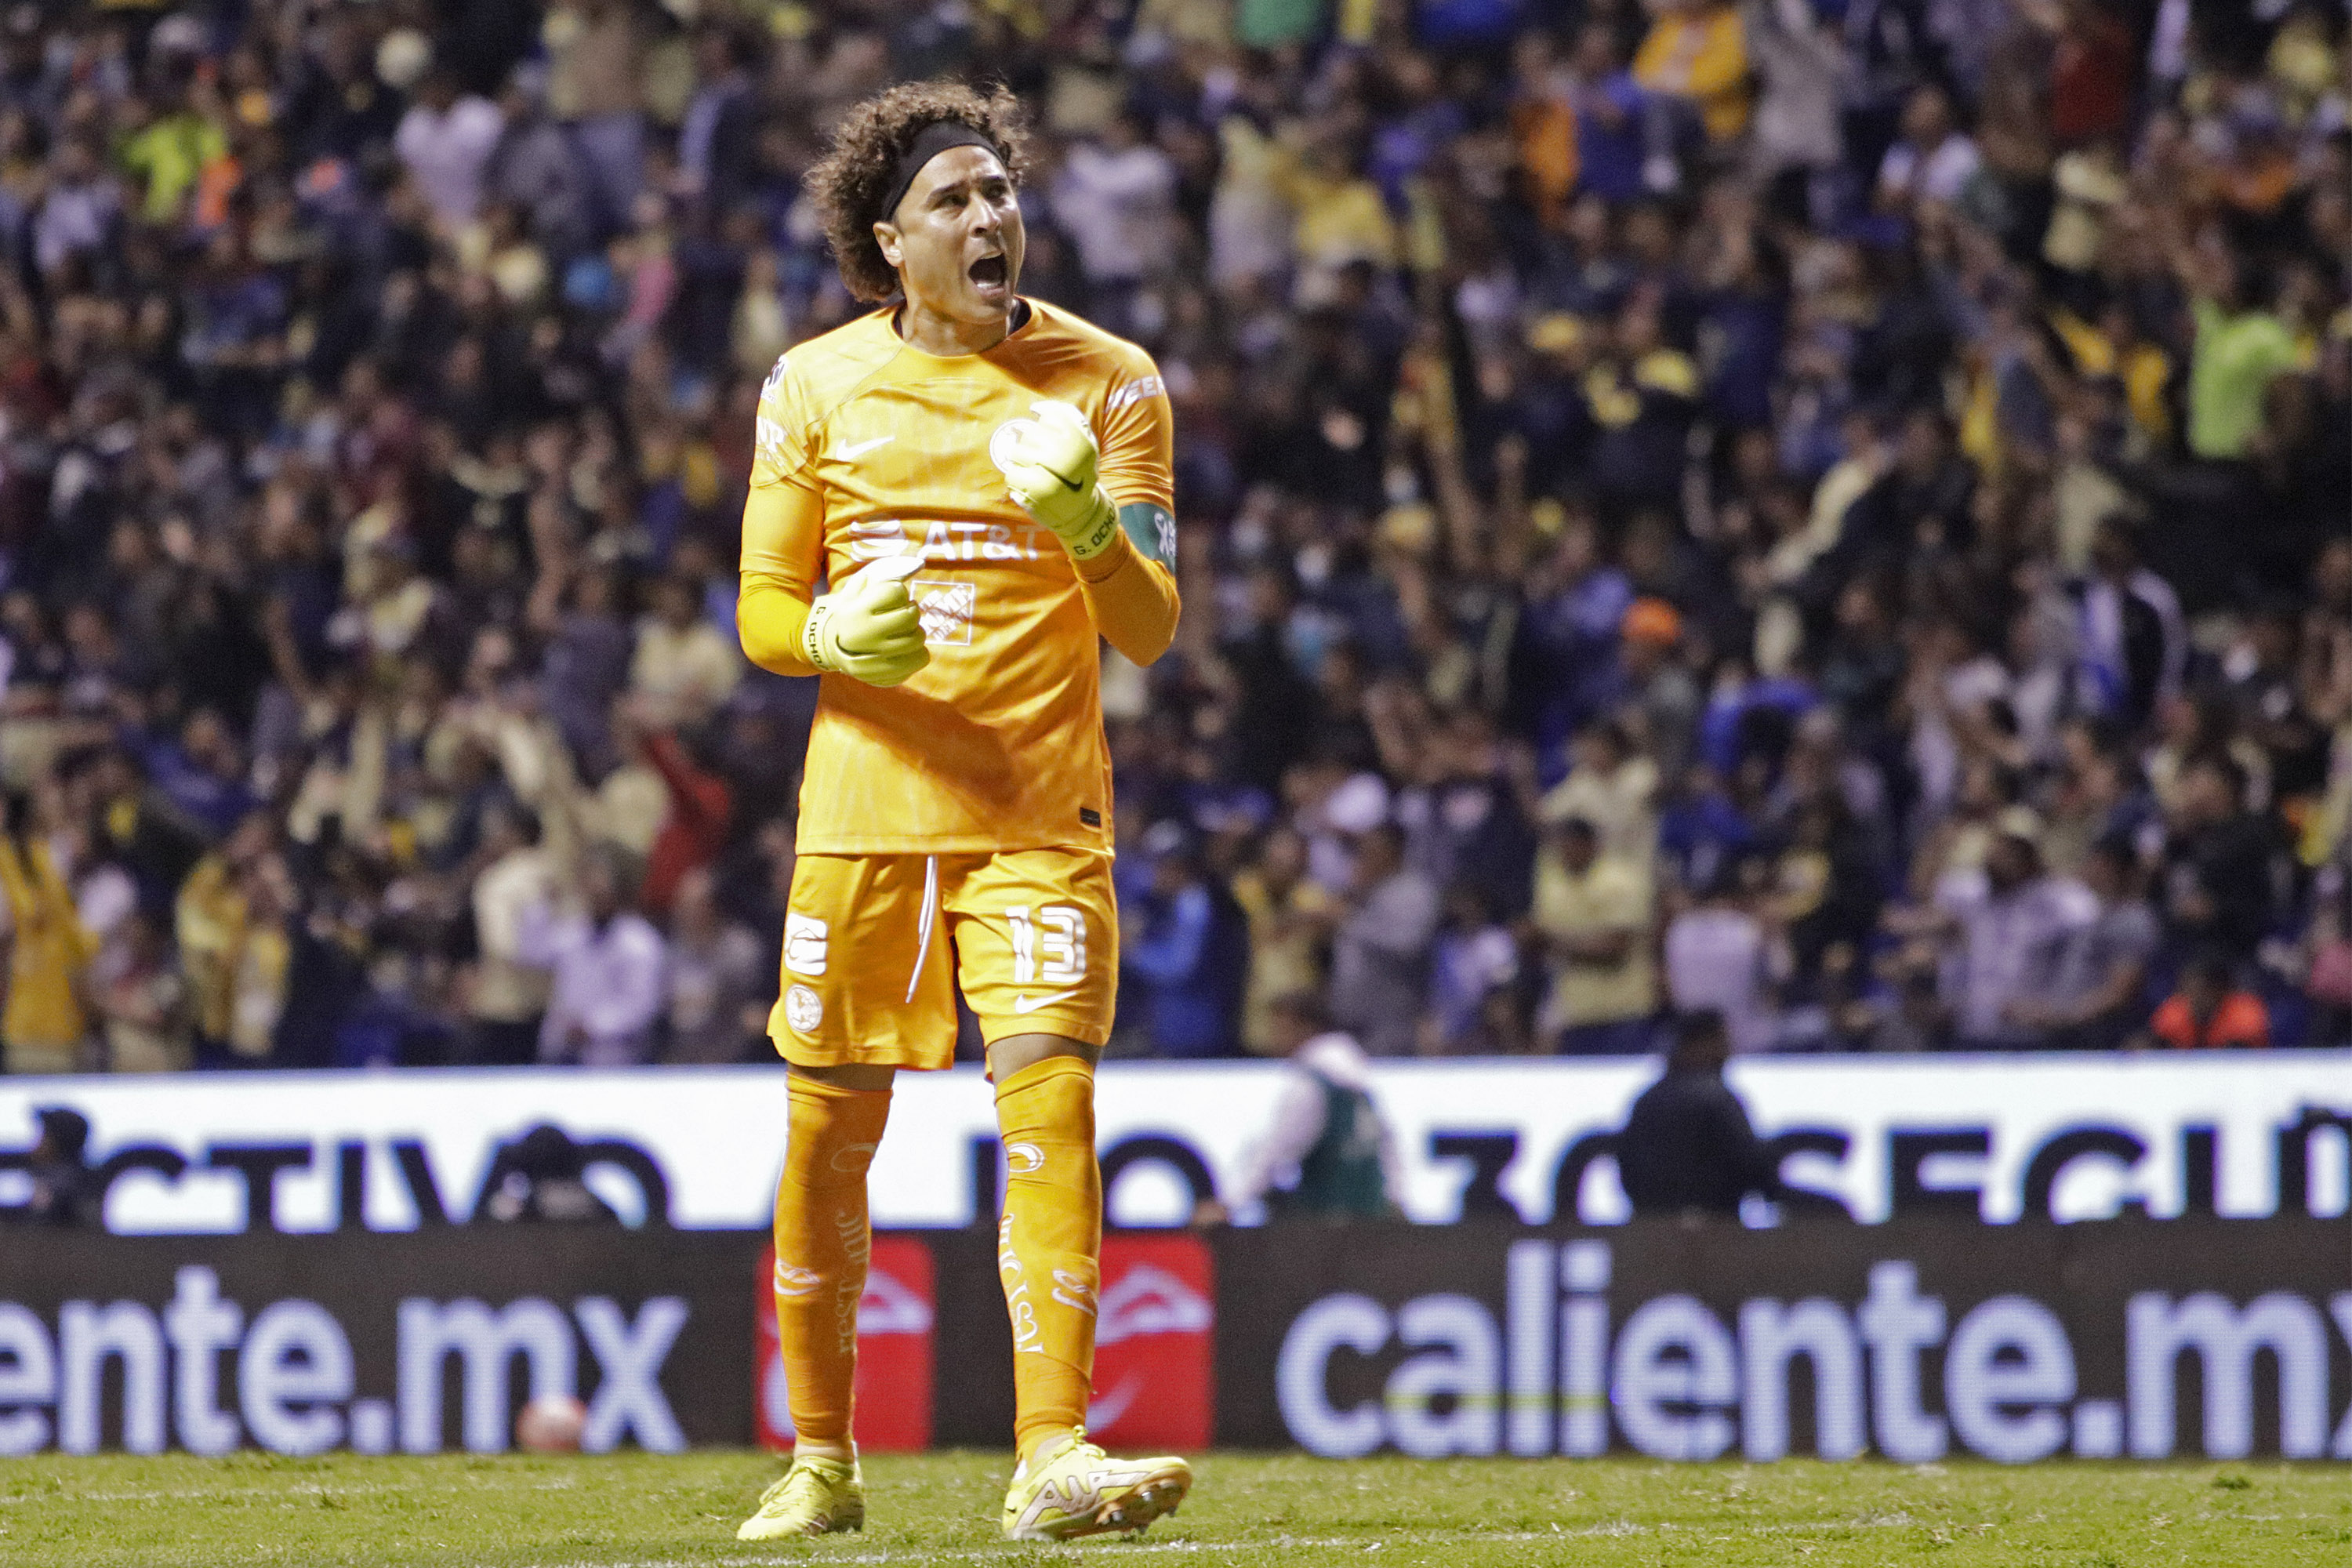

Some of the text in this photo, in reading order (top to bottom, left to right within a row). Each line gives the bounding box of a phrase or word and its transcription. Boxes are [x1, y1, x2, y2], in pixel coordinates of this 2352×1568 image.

[916, 521, 1045, 561] AT&T
[1005, 906, 1086, 982] 13
[1276, 1239, 2352, 1461] caliente.m
